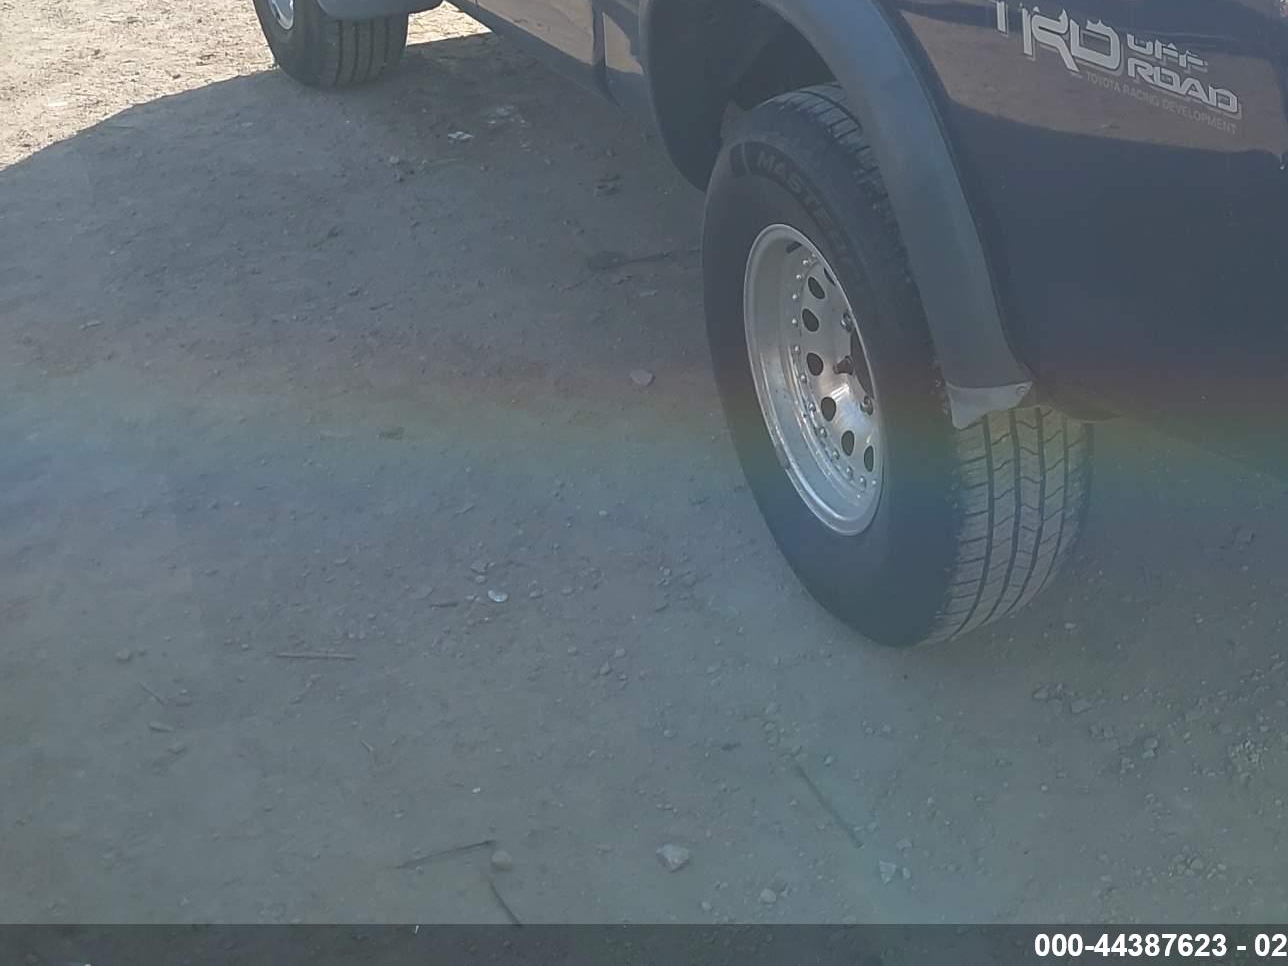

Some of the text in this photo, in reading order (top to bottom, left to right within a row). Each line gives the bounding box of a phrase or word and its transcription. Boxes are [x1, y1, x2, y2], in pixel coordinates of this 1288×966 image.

[1086, 71, 1238, 135] TOYOTA RACING DEVELOPMENT
[1127, 57, 1242, 119] ROAD
